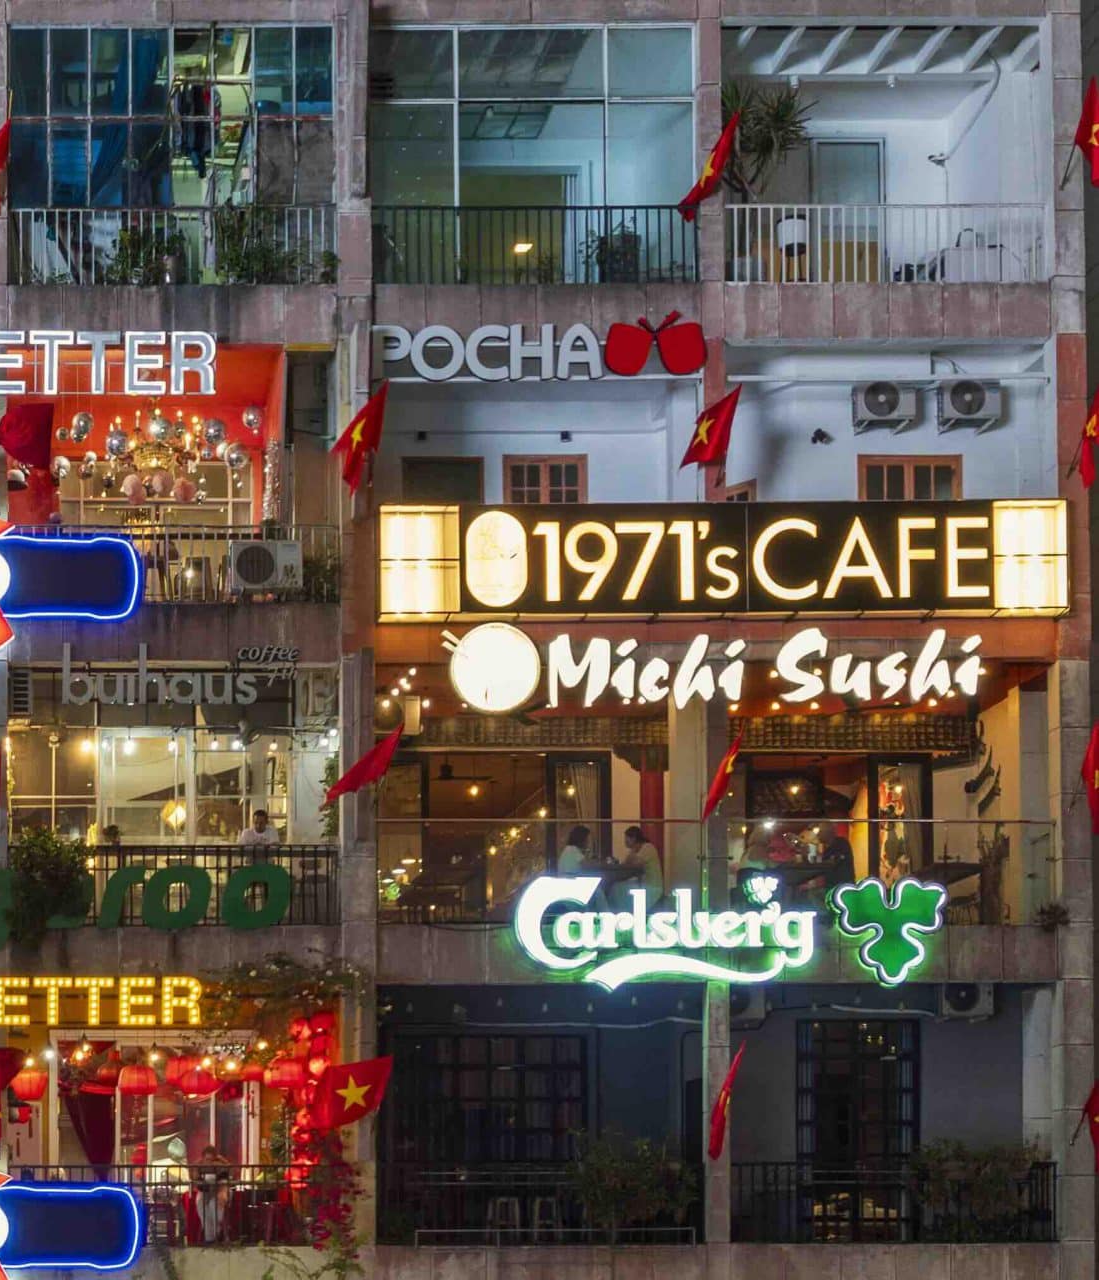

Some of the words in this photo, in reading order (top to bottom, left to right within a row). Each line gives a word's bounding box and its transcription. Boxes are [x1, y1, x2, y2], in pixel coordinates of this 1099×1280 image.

[371, 322, 603, 381] POCHA
[752, 516, 990, 600] CAFE
[237, 646, 299, 663] coffee
[547, 632, 747, 710] Michi
[775, 626, 985, 703] Sushi
[514, 875, 818, 984] Carlsberg
